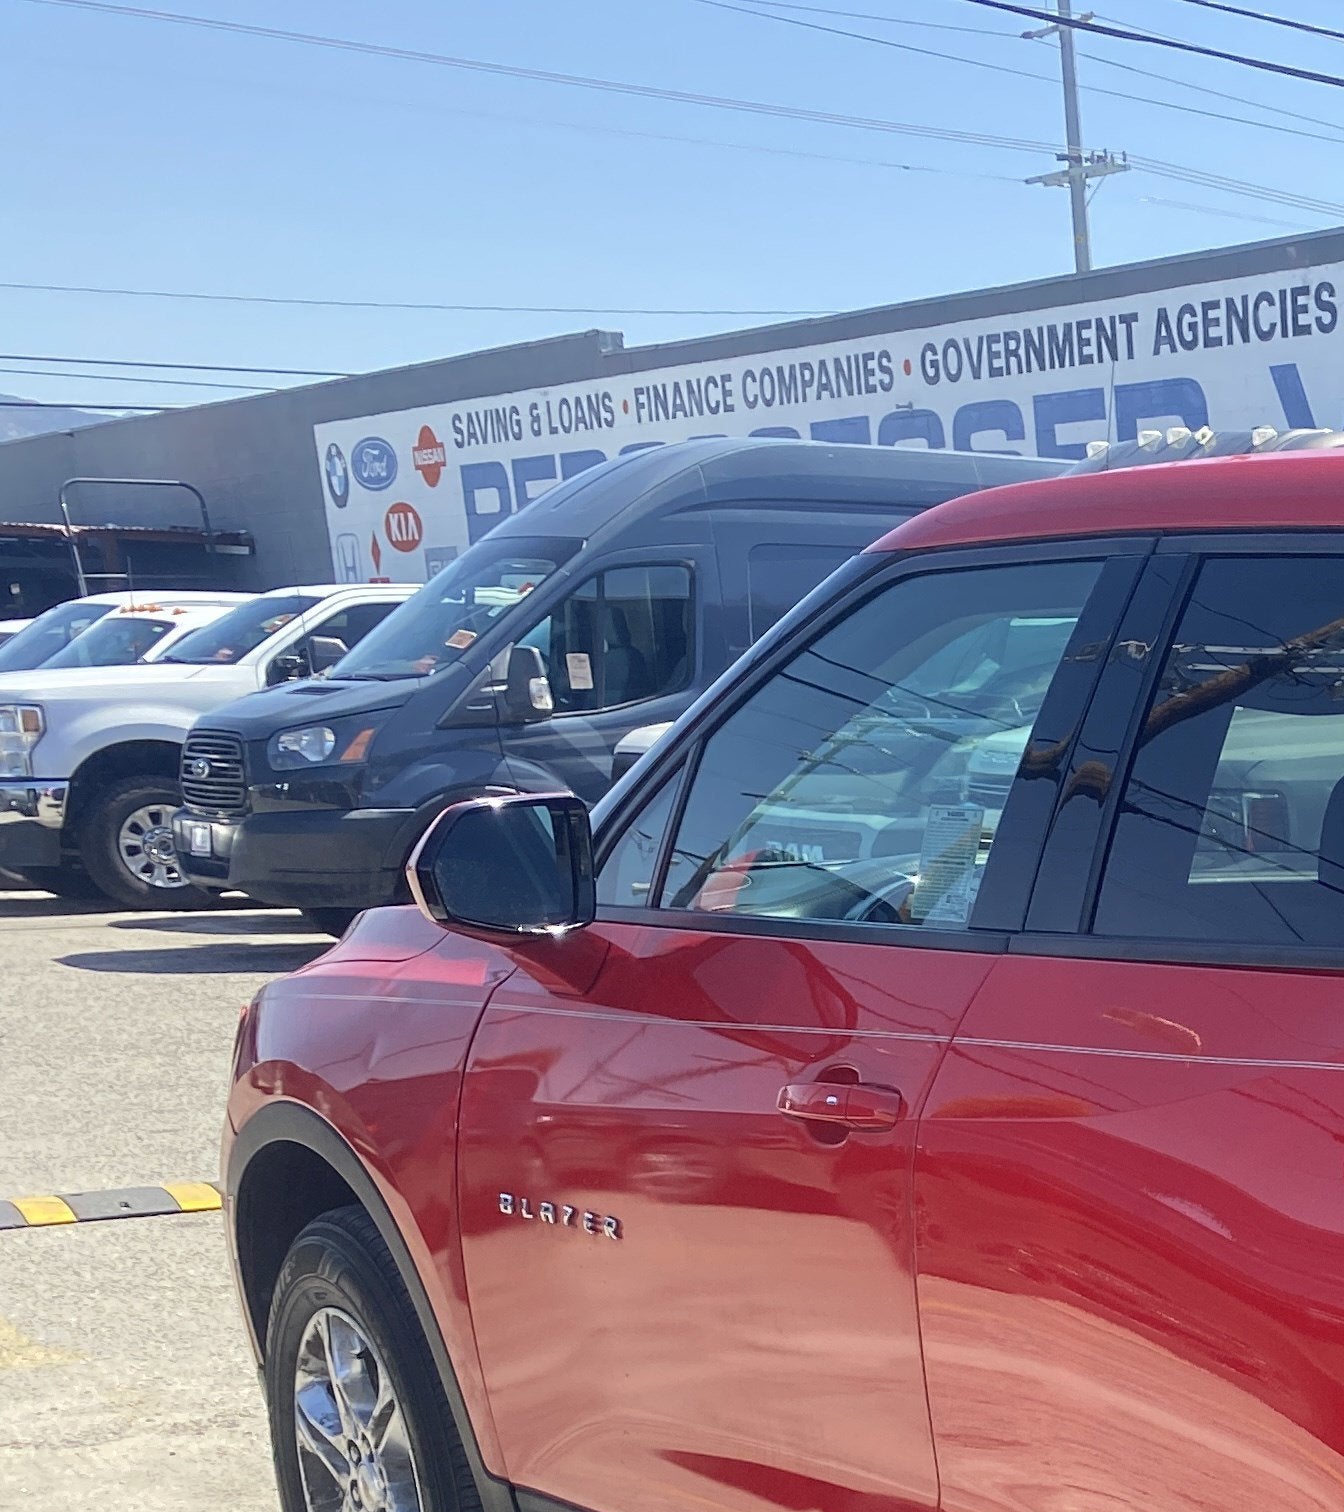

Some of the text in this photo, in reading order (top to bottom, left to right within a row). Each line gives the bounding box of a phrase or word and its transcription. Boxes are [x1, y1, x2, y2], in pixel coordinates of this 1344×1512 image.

[452, 406, 522, 448] SAVING
[529, 402, 541, 437] &
[546, 391, 615, 435] LOANS
[634, 373, 735, 424] FINANCE
[742, 349, 894, 410] COMPANIES
[920, 311, 1139, 386] GOVERNMENT
[1153, 281, 1338, 357] AGENCIES
[361, 447, 388, 478] Ford
[414, 447, 445, 466] NISSAN
[388, 511, 419, 542] KIA
[499, 1192, 623, 1241] BLAZER
